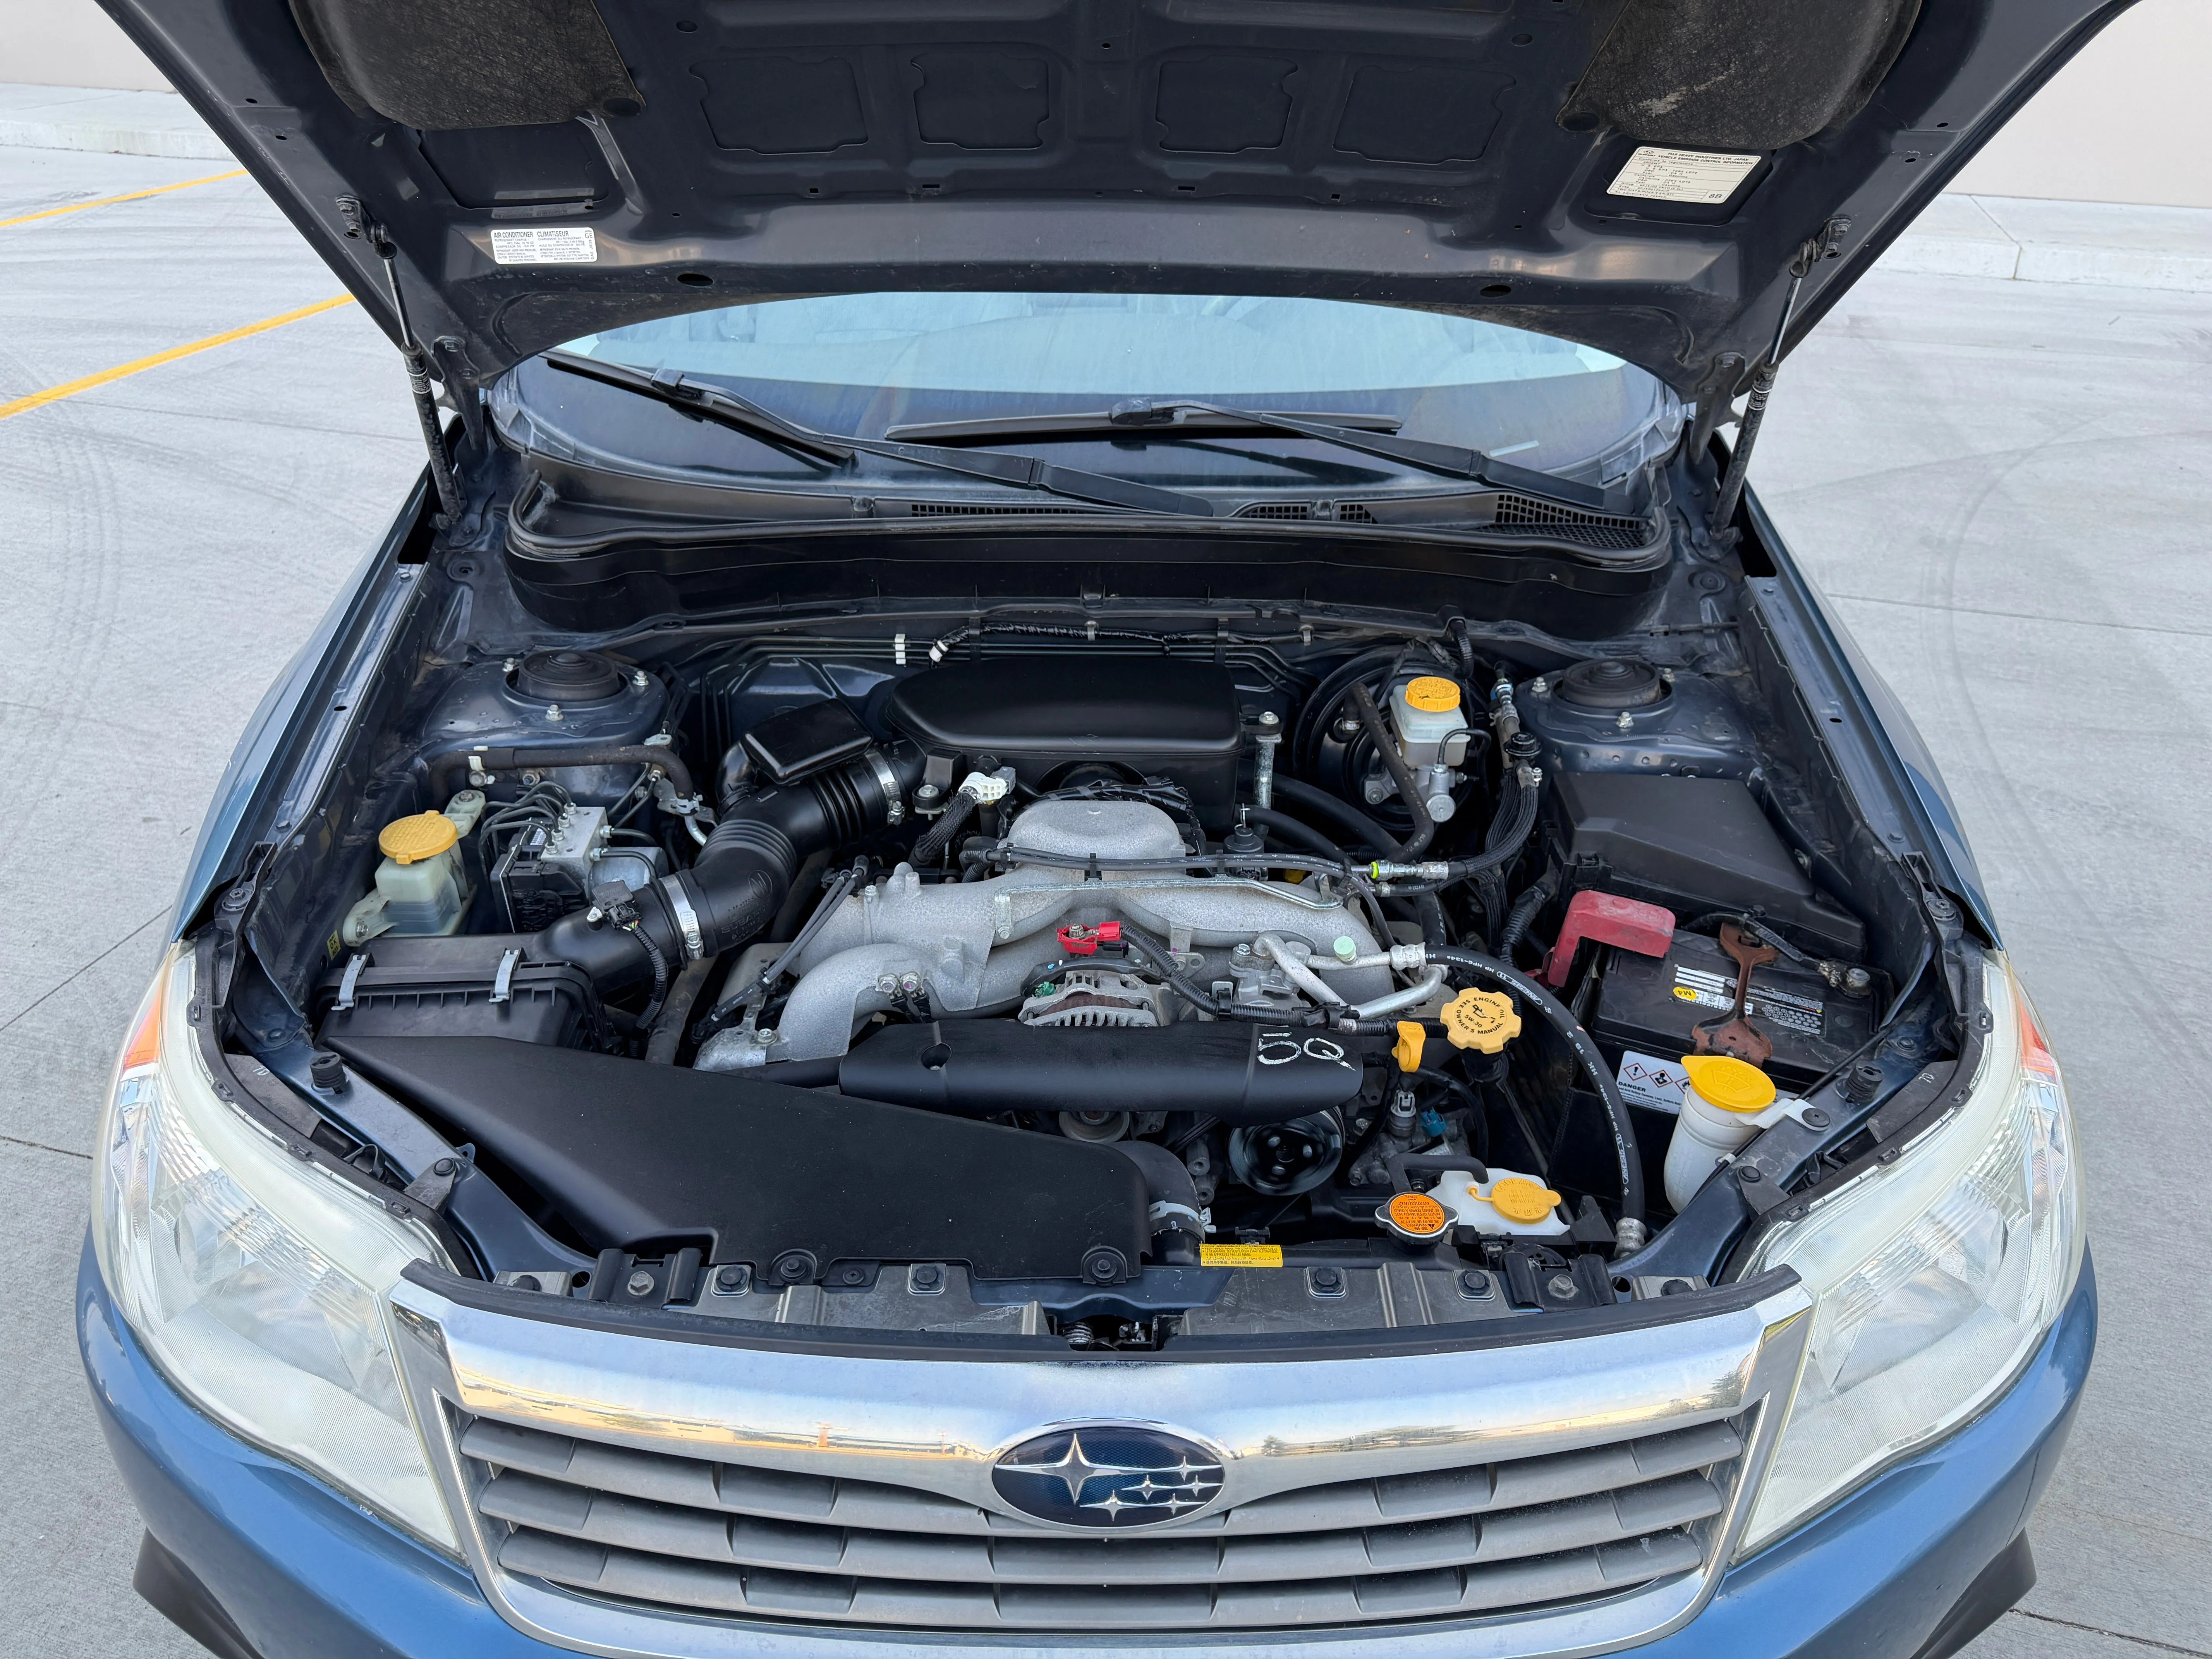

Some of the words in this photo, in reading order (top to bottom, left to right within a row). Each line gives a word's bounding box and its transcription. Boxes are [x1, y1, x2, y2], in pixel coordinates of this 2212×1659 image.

[1459, 999, 1470, 1008] SEE
[1456, 1010, 1475, 1033] OWNER'S
[1464, 1014, 1483, 1028] 5W-30
[1477, 1022, 1503, 1034] MANUAL
[1587, 1061, 1599, 1076] HK
[1618, 1081, 1646, 1092] DANGER
[1494, 1178, 1534, 1192] COOLAN
